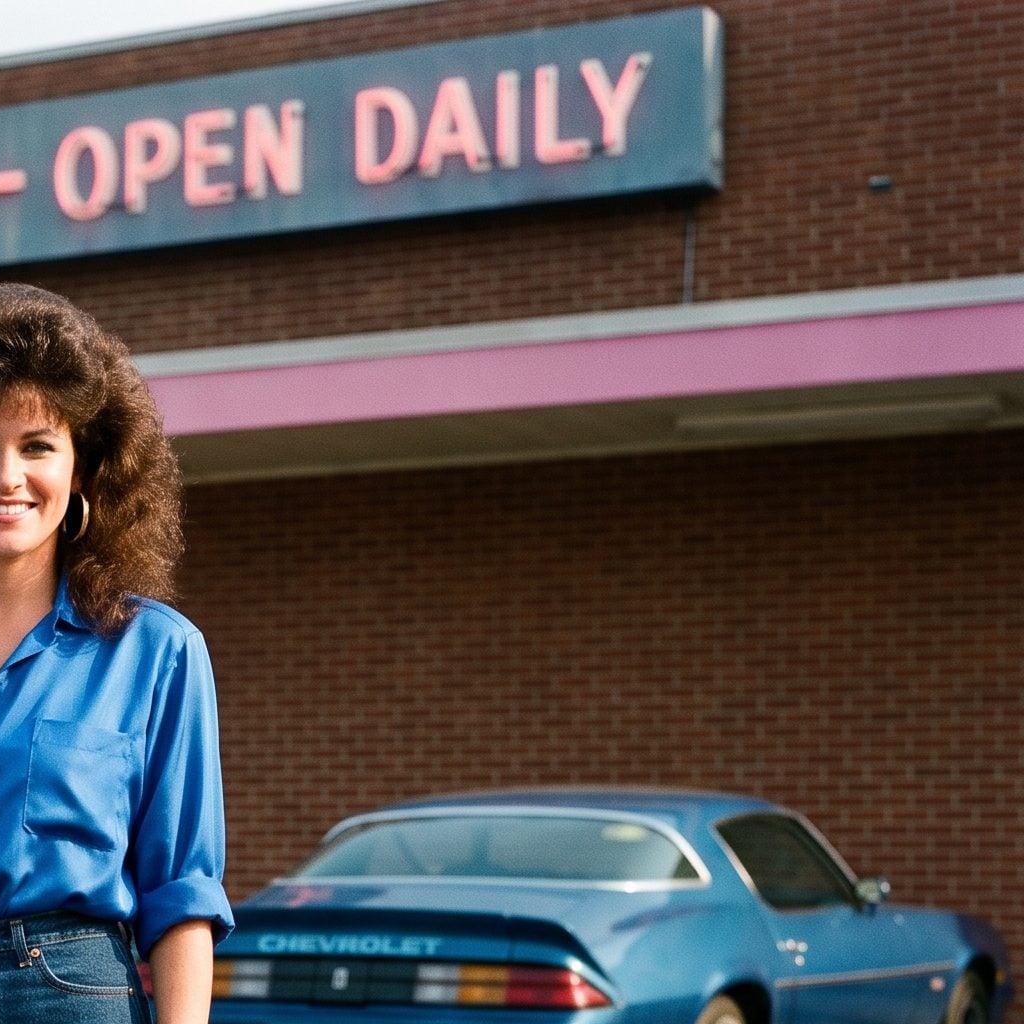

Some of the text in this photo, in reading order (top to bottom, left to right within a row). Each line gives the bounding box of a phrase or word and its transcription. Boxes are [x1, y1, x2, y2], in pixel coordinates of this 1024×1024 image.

[53, 101, 305, 221] OPEN
[354, 52, 654, 185] DAILY
[257, 934, 443, 956] CHEVROLET
